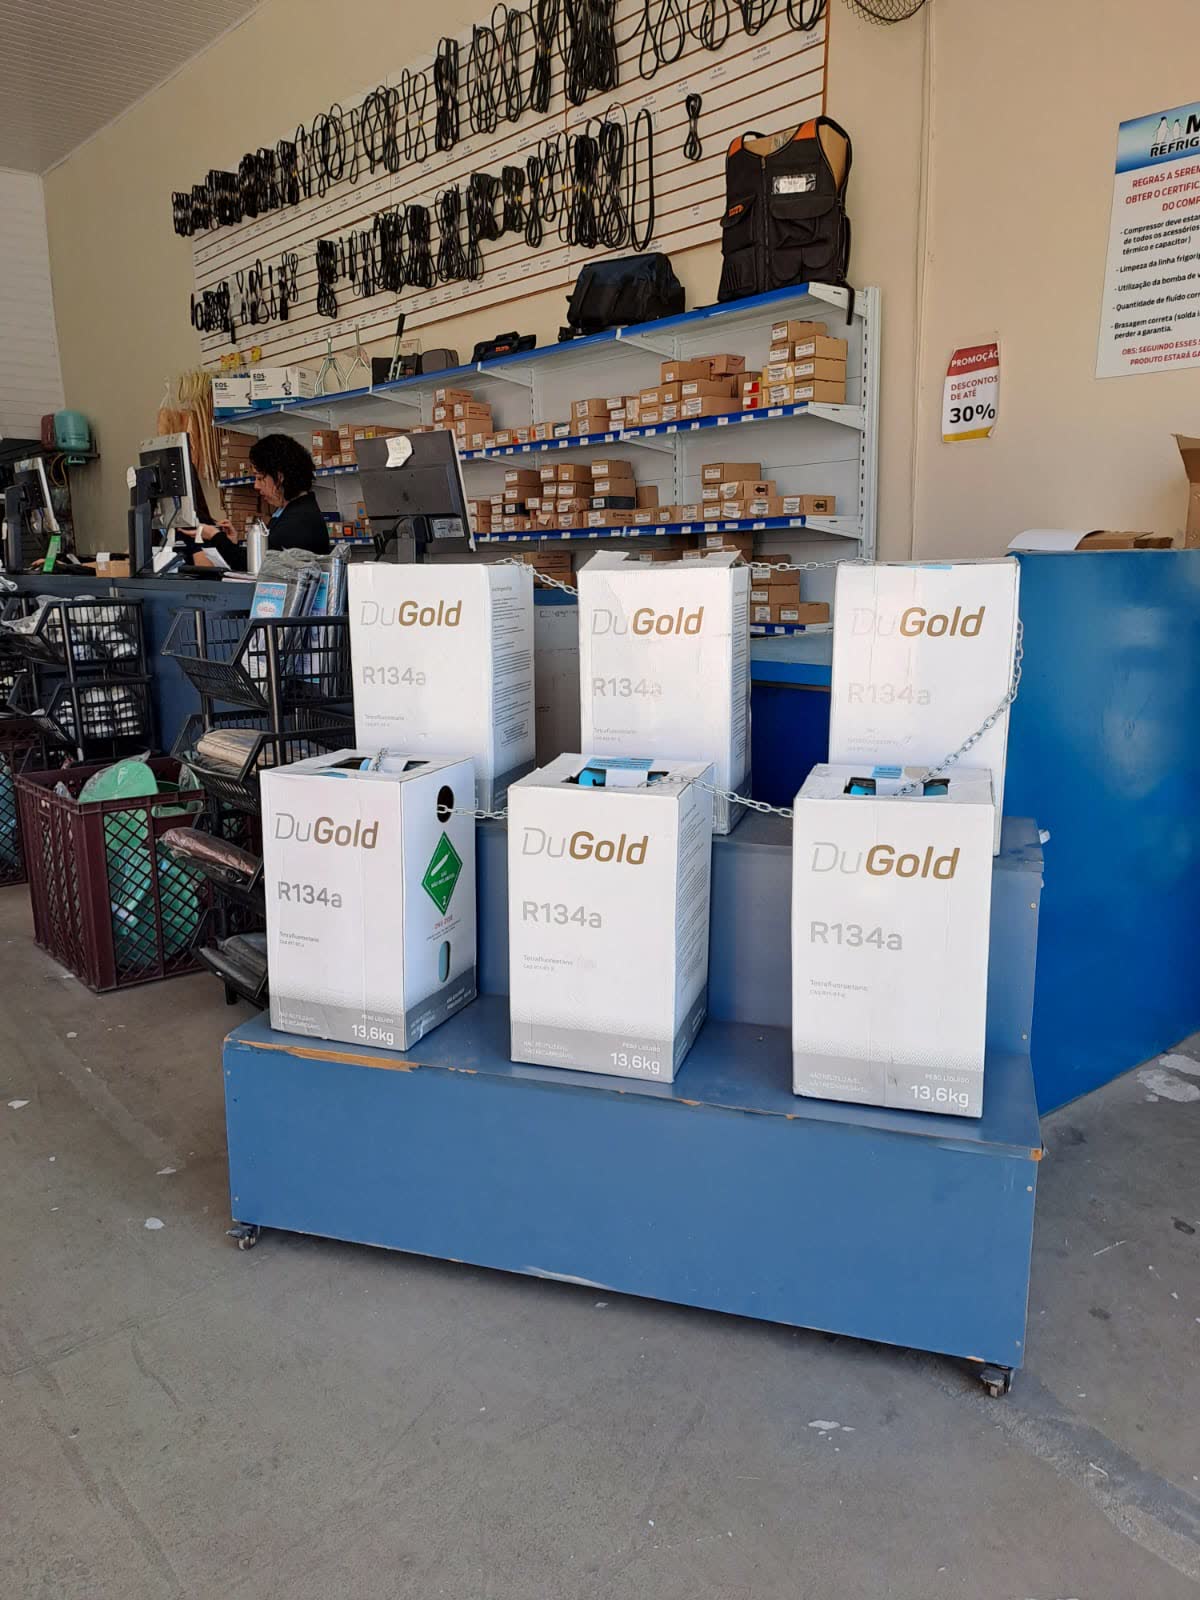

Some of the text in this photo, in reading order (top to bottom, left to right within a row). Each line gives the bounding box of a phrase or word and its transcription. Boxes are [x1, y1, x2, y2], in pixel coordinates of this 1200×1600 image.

[1150, 136, 1200, 157] REFRIG
[1132, 173, 1165, 188] REGRAS
[1166, 172, 1173, 181] A
[1125, 181, 1200, 204] OBTER O CERTIFIC
[1162, 202, 1174, 211] DO
[1124, 221, 1164, 236] Compressor
[1165, 217, 1181, 227] deve
[1133, 234, 1152, 243] todos
[1163, 224, 1200, 237] acessórios
[1123, 244, 1148, 255] térmico
[1120, 262, 1147, 273] Limpeza
[1149, 260, 1157, 268] da
[1158, 256, 1175, 266] linha
[1118, 280, 1151, 292] Utilização
[1152, 278, 1160, 286] da
[1162, 274, 1186, 284] bomba
[1116, 299, 1154, 312] Quantidade
[1114, 318, 1147, 330] Brasagem
[1148, 315, 1172, 324] correta
[1174, 311, 1196, 322] (solda
[1114, 330, 1136, 340] perder
[1142, 325, 1171, 337] garantia.
[1139, 342, 1174, 353] SEGUINDO
[1175, 339, 1197, 348] ESSES
[1130, 355, 1162, 365] PRODUTO
[1163, 350, 1190, 362] ESTARÁ
[951, 375, 998, 391] DESCONTOS
[963, 389, 977, 399] ATÉ
[949, 403, 996, 424] 30%
[360, 600, 462, 627] DuGold
[592, 606, 704, 635] DuGold
[851, 606, 986, 637] DuGold
[362, 666, 426, 685] R134a
[592, 678, 662, 697] R134a
[848, 682, 931, 705] R134a
[275, 812, 379, 849] DuGold
[522, 826, 649, 865] DuGold
[811, 841, 961, 880] DuGold
[277, 881, 343, 908] R134a
[522, 901, 602, 929] R134a
[810, 921, 903, 951] R134a
[352, 1024, 394, 1046] 13,6kg
[610, 1052, 660, 1075] 13,6kg
[910, 1085, 969, 1107] 13,6kg
